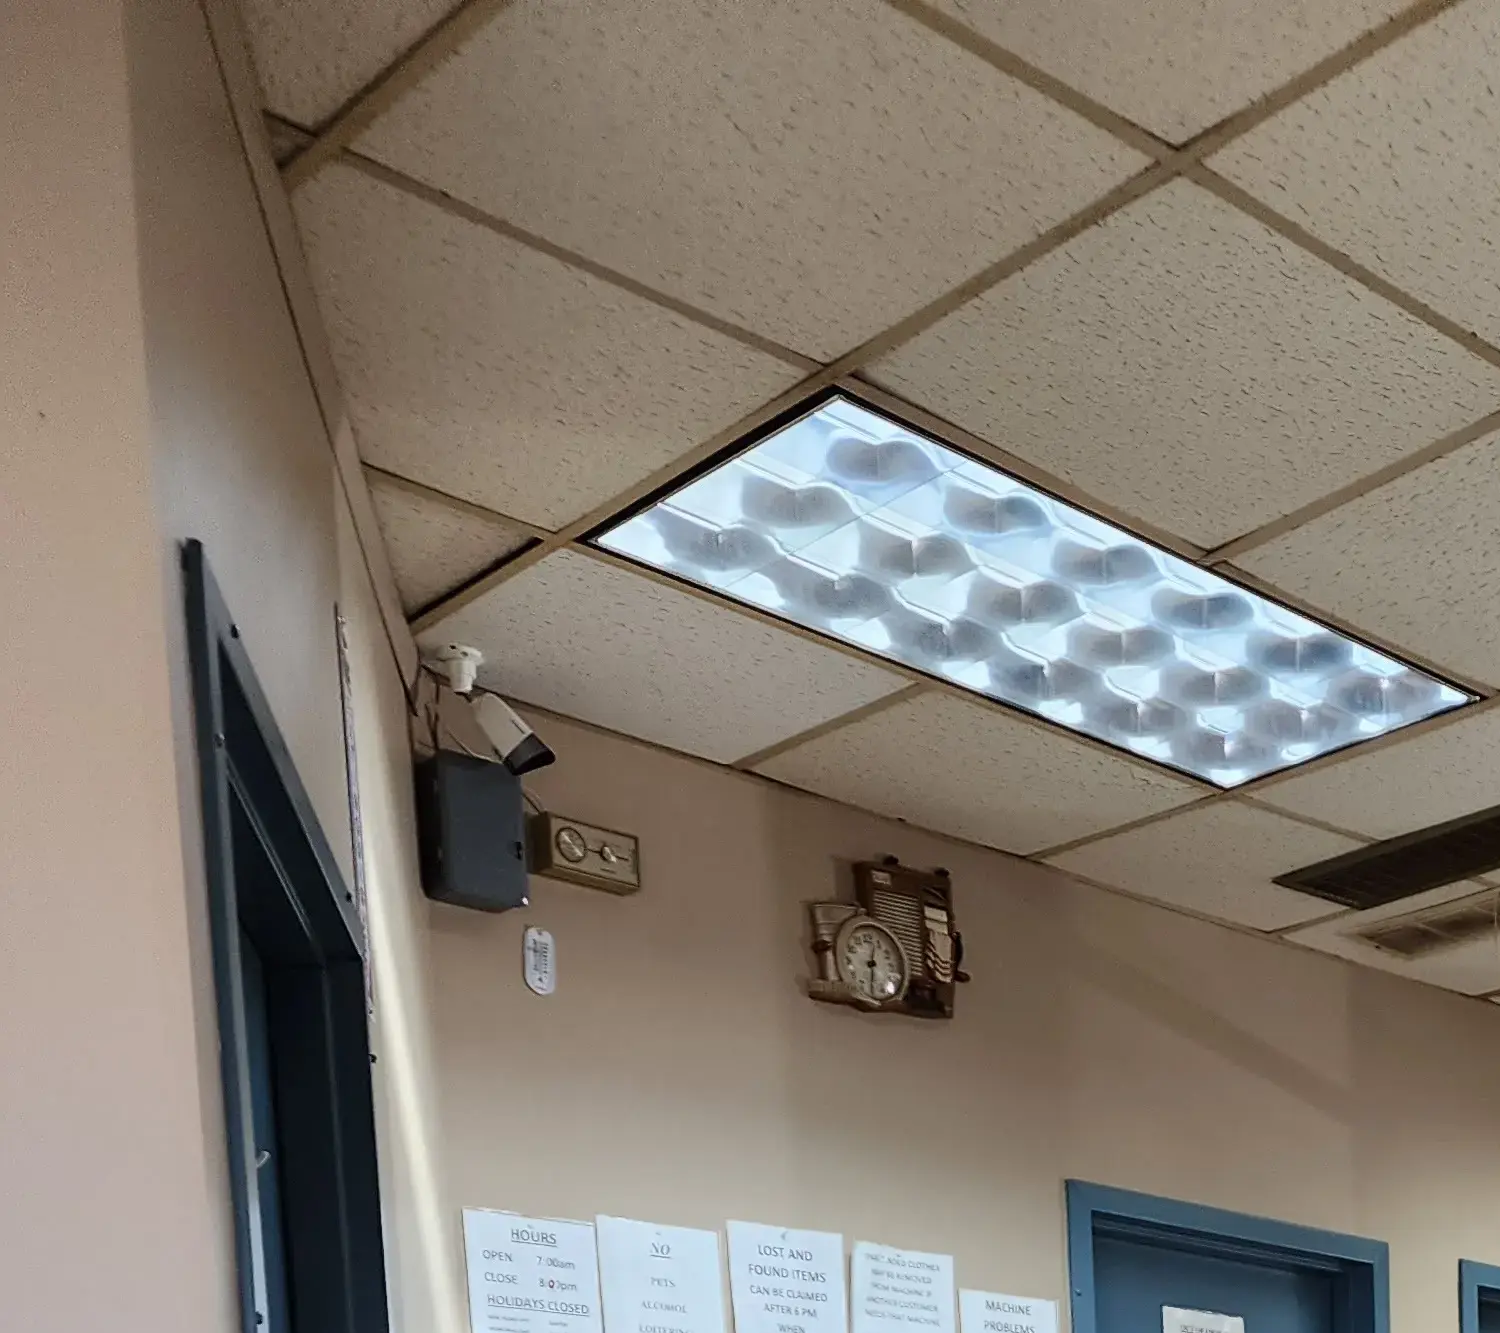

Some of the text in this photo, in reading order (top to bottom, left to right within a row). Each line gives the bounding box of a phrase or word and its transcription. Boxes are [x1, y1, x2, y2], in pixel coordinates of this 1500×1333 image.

[511, 1228, 557, 1245] HOURS
[482, 1249, 513, 1262] OPEN
[650, 1241, 671, 1257] NO
[757, 1244, 813, 1262] LOST AND
[484, 1271, 519, 1285] CLOSE
[748, 1263, 826, 1284] FOUND ITEMS
[650, 1277, 676, 1288] PETS
[749, 1285, 828, 1303] CAN BE CLAIMED
[486, 1294, 590, 1315] HOLIDAYS CLOSED
[641, 1300, 688, 1314] ALCOHOL
[764, 1303, 792, 1315] AFTER
[985, 1299, 1033, 1316] MACHINE
